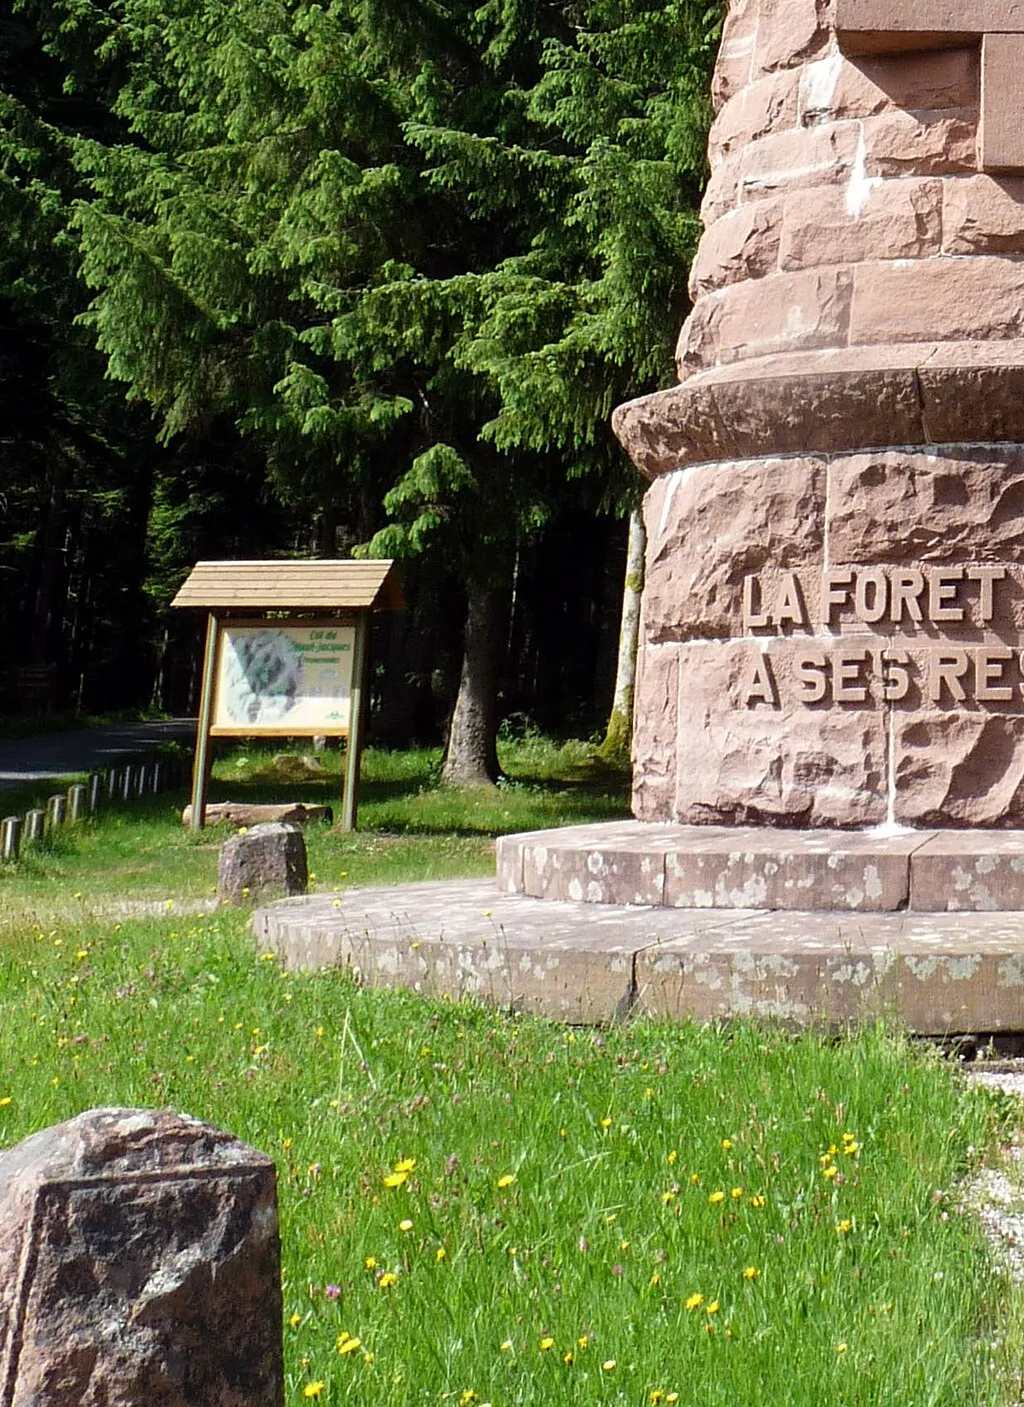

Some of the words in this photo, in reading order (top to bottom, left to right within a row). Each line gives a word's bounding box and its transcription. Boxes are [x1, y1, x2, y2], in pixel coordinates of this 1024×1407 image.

[744, 573, 803, 627] LA
[823, 565, 1006, 623] FORET
[744, 651, 775, 703] A
[793, 649, 909, 703] SES
